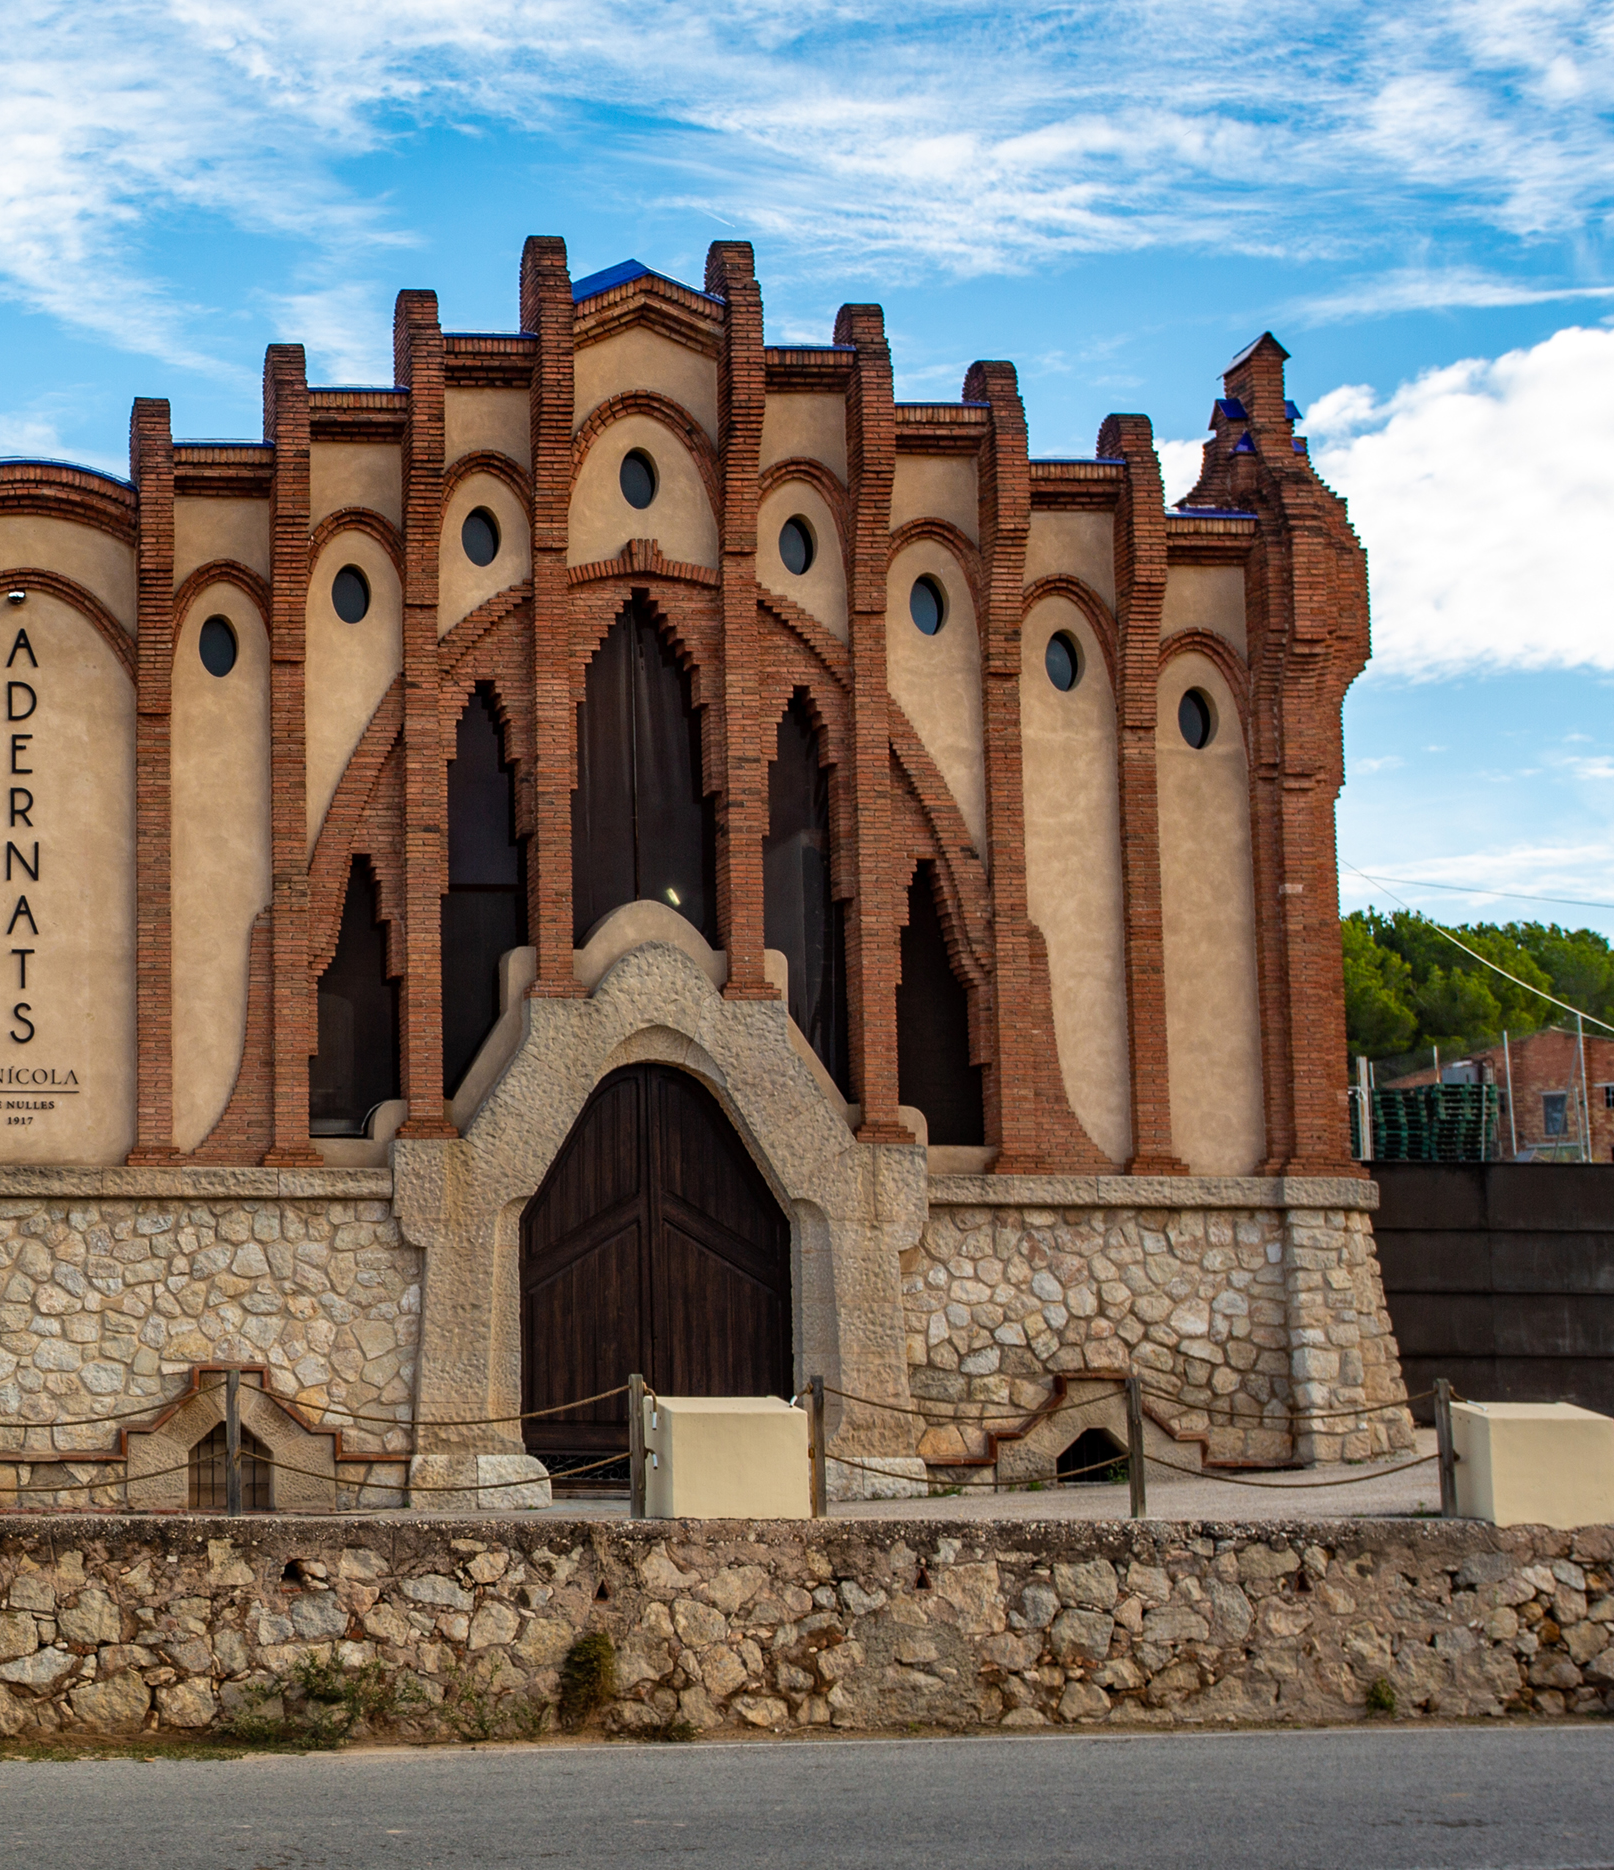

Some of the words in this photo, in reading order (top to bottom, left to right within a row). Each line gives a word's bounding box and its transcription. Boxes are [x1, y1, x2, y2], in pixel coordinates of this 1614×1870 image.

[6, 627, 40, 1044] ADERNATS
[6, 1100, 55, 1110] NULLES
[7, 1116, 33, 1126] 1917
